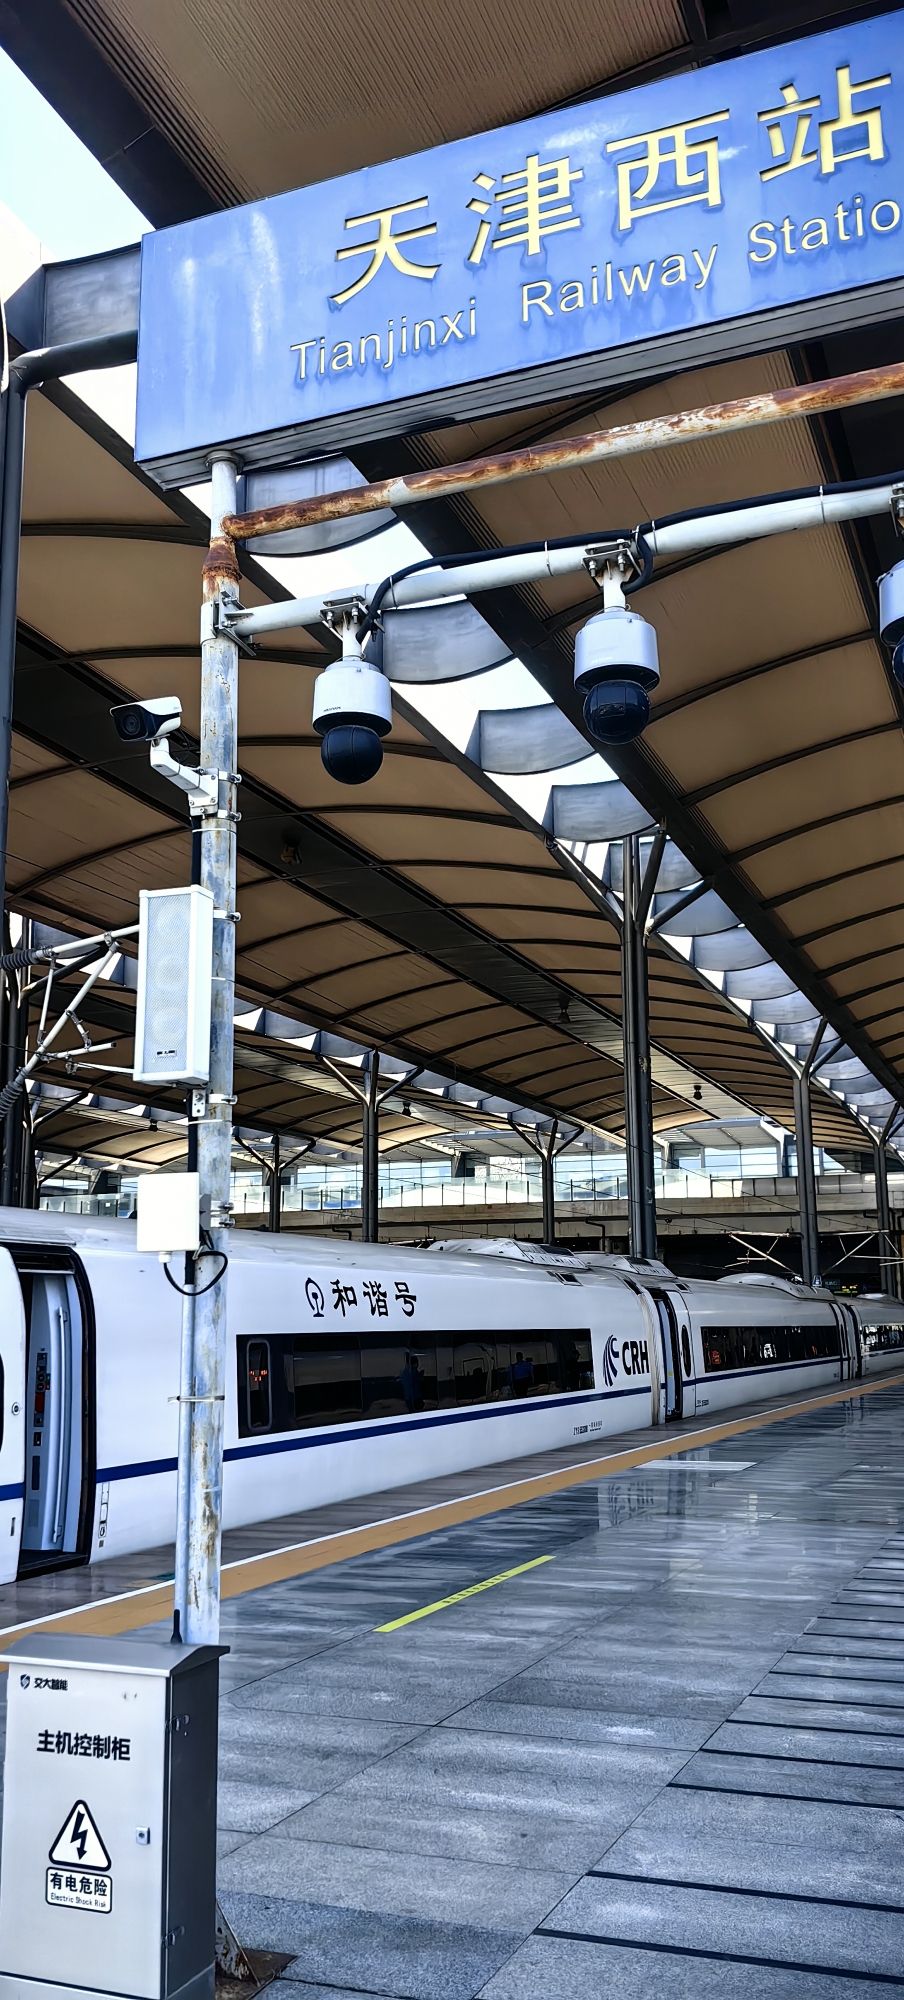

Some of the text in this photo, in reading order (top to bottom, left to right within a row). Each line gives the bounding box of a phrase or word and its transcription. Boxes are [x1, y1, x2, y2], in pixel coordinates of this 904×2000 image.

[328, 64, 892, 306] 天津西站
[290, 299, 477, 381] Tianjinxi
[521, 244, 716, 322] Railway
[330, 1279, 416, 1317] 和谐号
[622, 1340, 650, 1375] CRH
[37, 1729, 131, 1760] 主机控制柜
[50, 1872, 107, 1896] 有电危险
